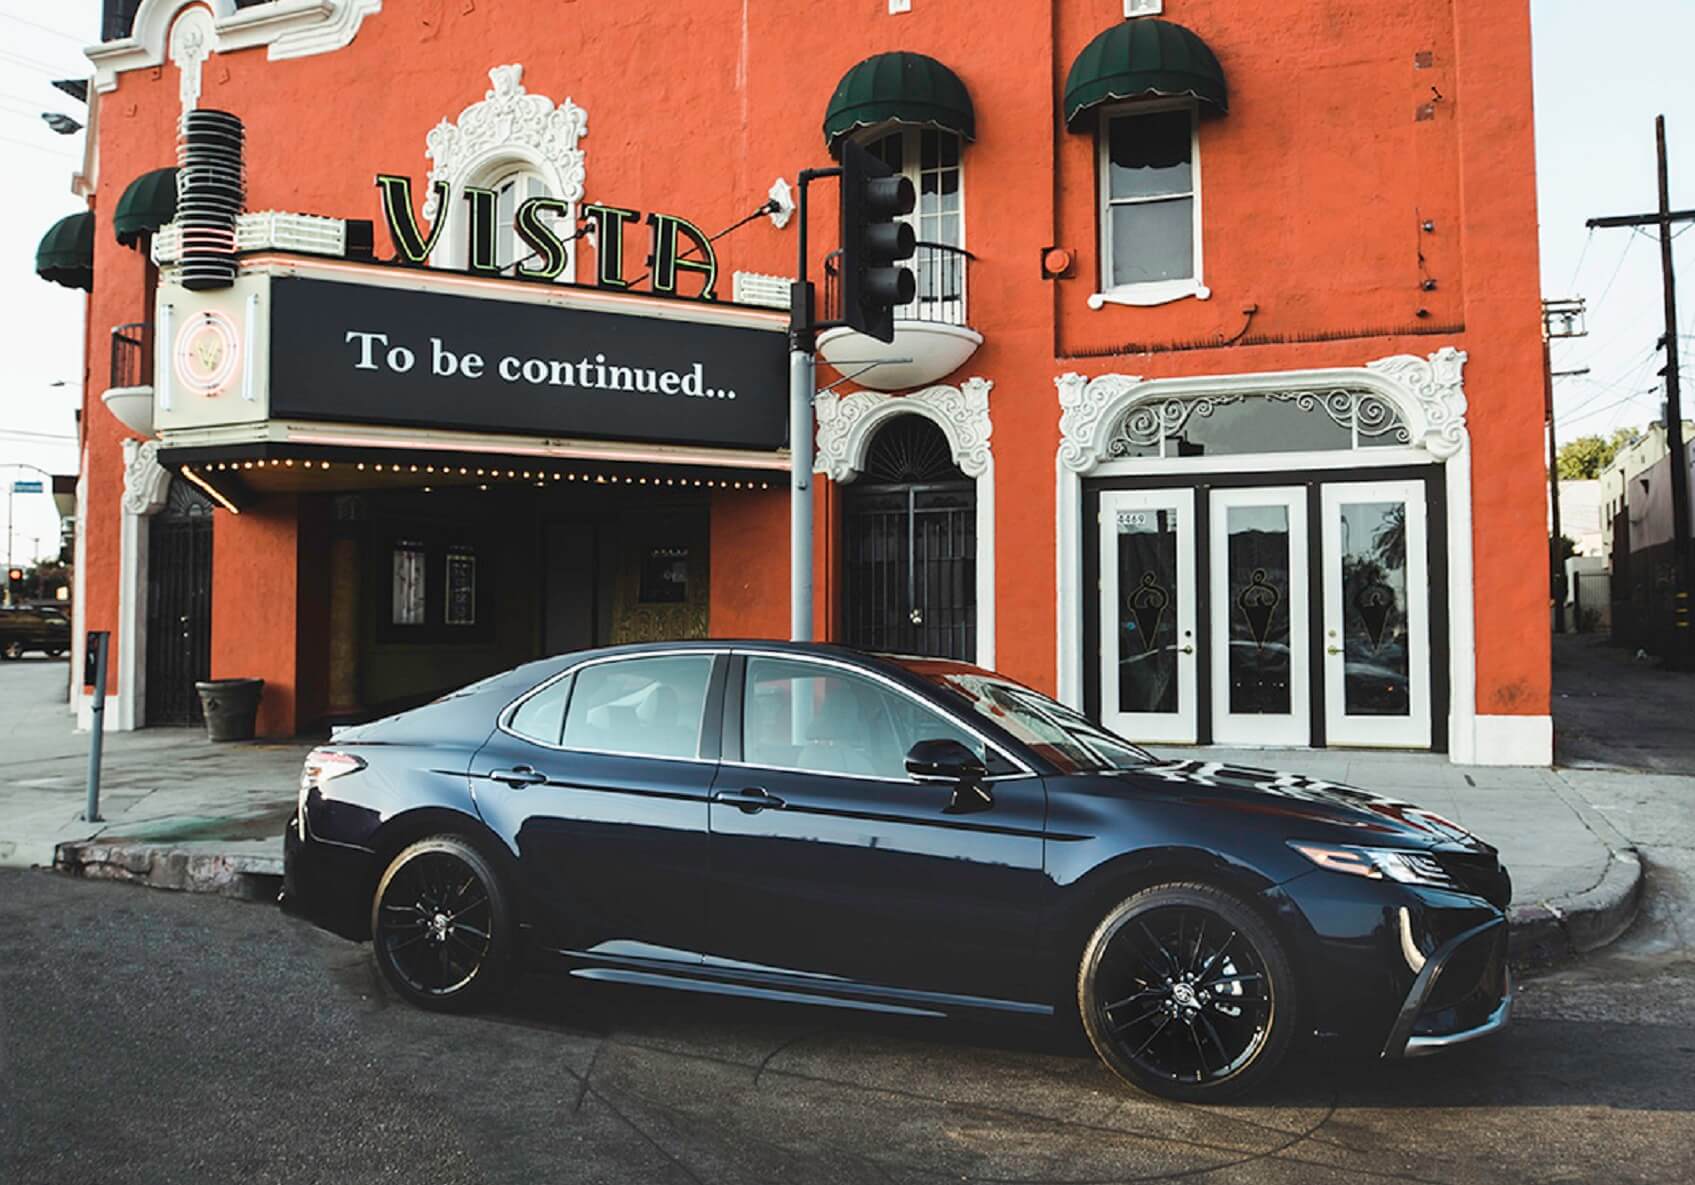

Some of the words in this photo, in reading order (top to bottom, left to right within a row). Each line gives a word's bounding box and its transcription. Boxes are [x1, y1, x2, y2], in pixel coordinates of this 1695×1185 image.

[375, 174, 718, 299] VISTA
[345, 331, 415, 373] To
[429, 337, 485, 379] be
[498, 353, 737, 400] continued...
